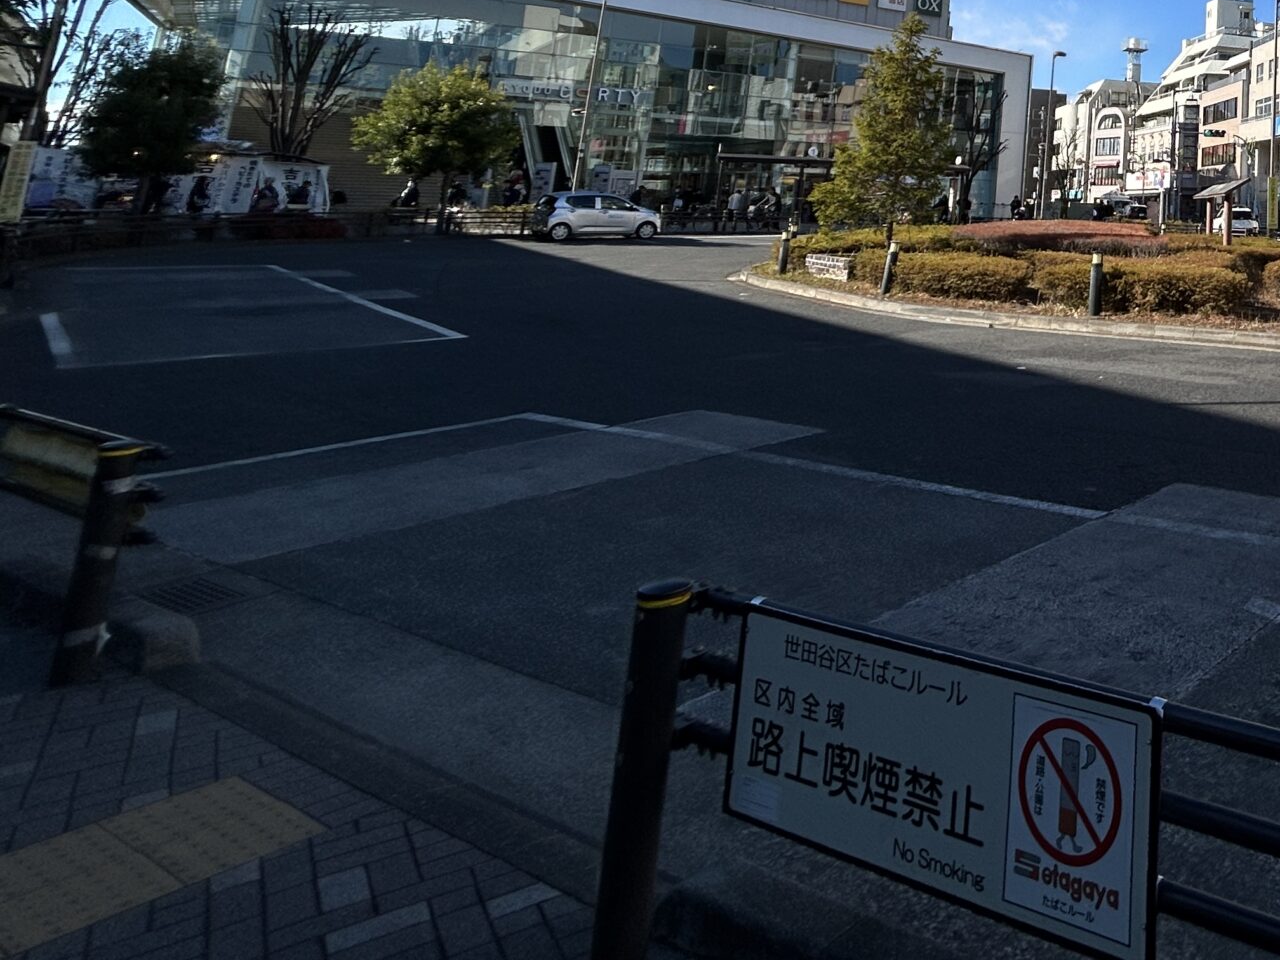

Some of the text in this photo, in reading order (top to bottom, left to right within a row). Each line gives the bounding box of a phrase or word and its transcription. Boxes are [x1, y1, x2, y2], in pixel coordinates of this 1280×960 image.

[784, 633, 968, 706] 世田谷区たばこルール
[753, 678, 845, 731] 区内全域
[746, 716, 985, 848] 路上喫煙禁止
[1094, 777, 1107, 824] 禁煙です
[892, 837, 986, 892] No Smoking
[1041, 894, 1095, 923] たばこルール
